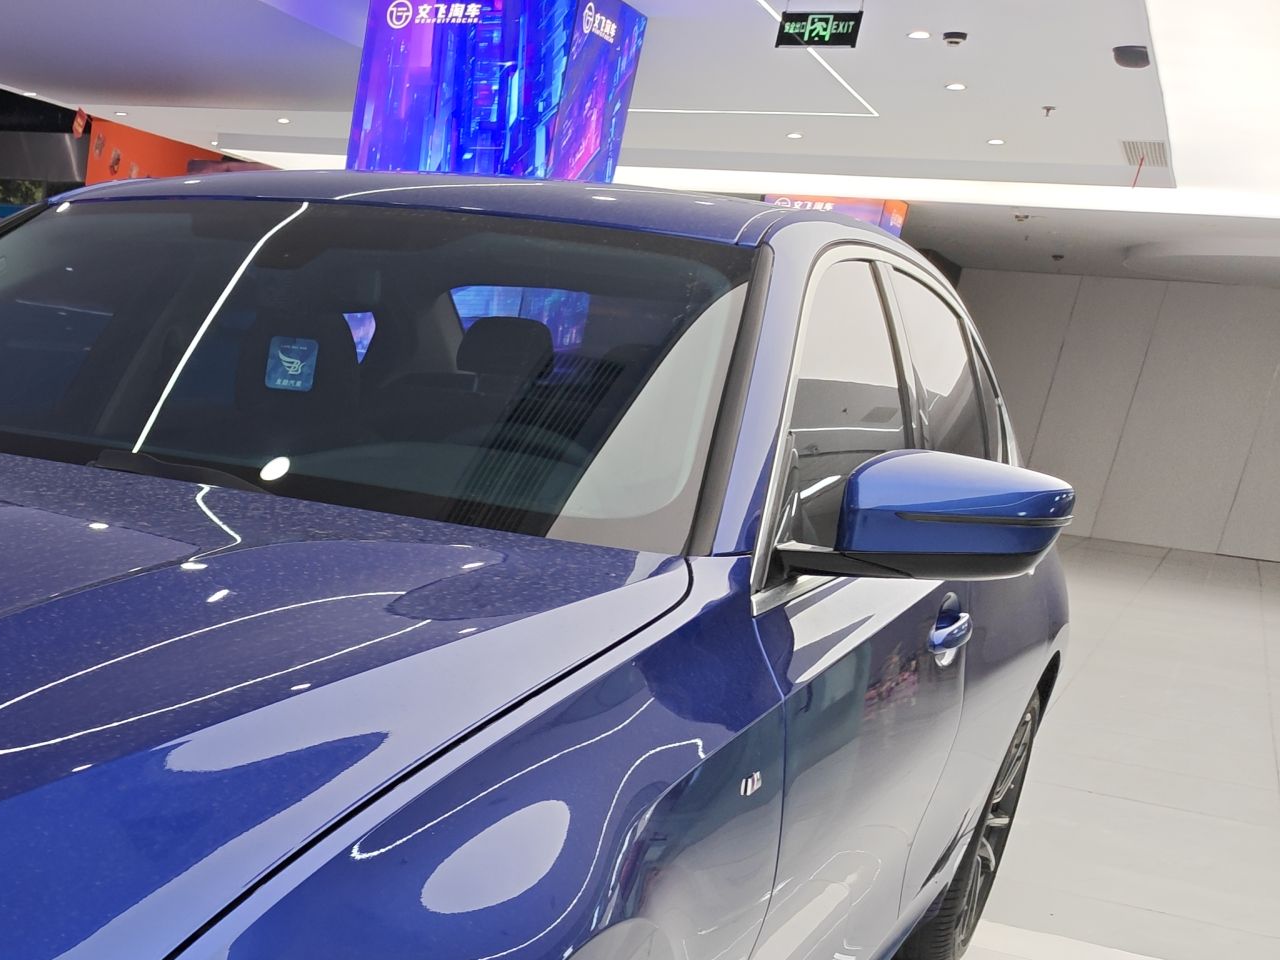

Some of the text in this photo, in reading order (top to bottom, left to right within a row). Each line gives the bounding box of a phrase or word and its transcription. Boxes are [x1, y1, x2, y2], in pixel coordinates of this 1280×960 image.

[416, 3, 481, 18] 文飞淘车
[831, 21, 855, 33] EXIT
